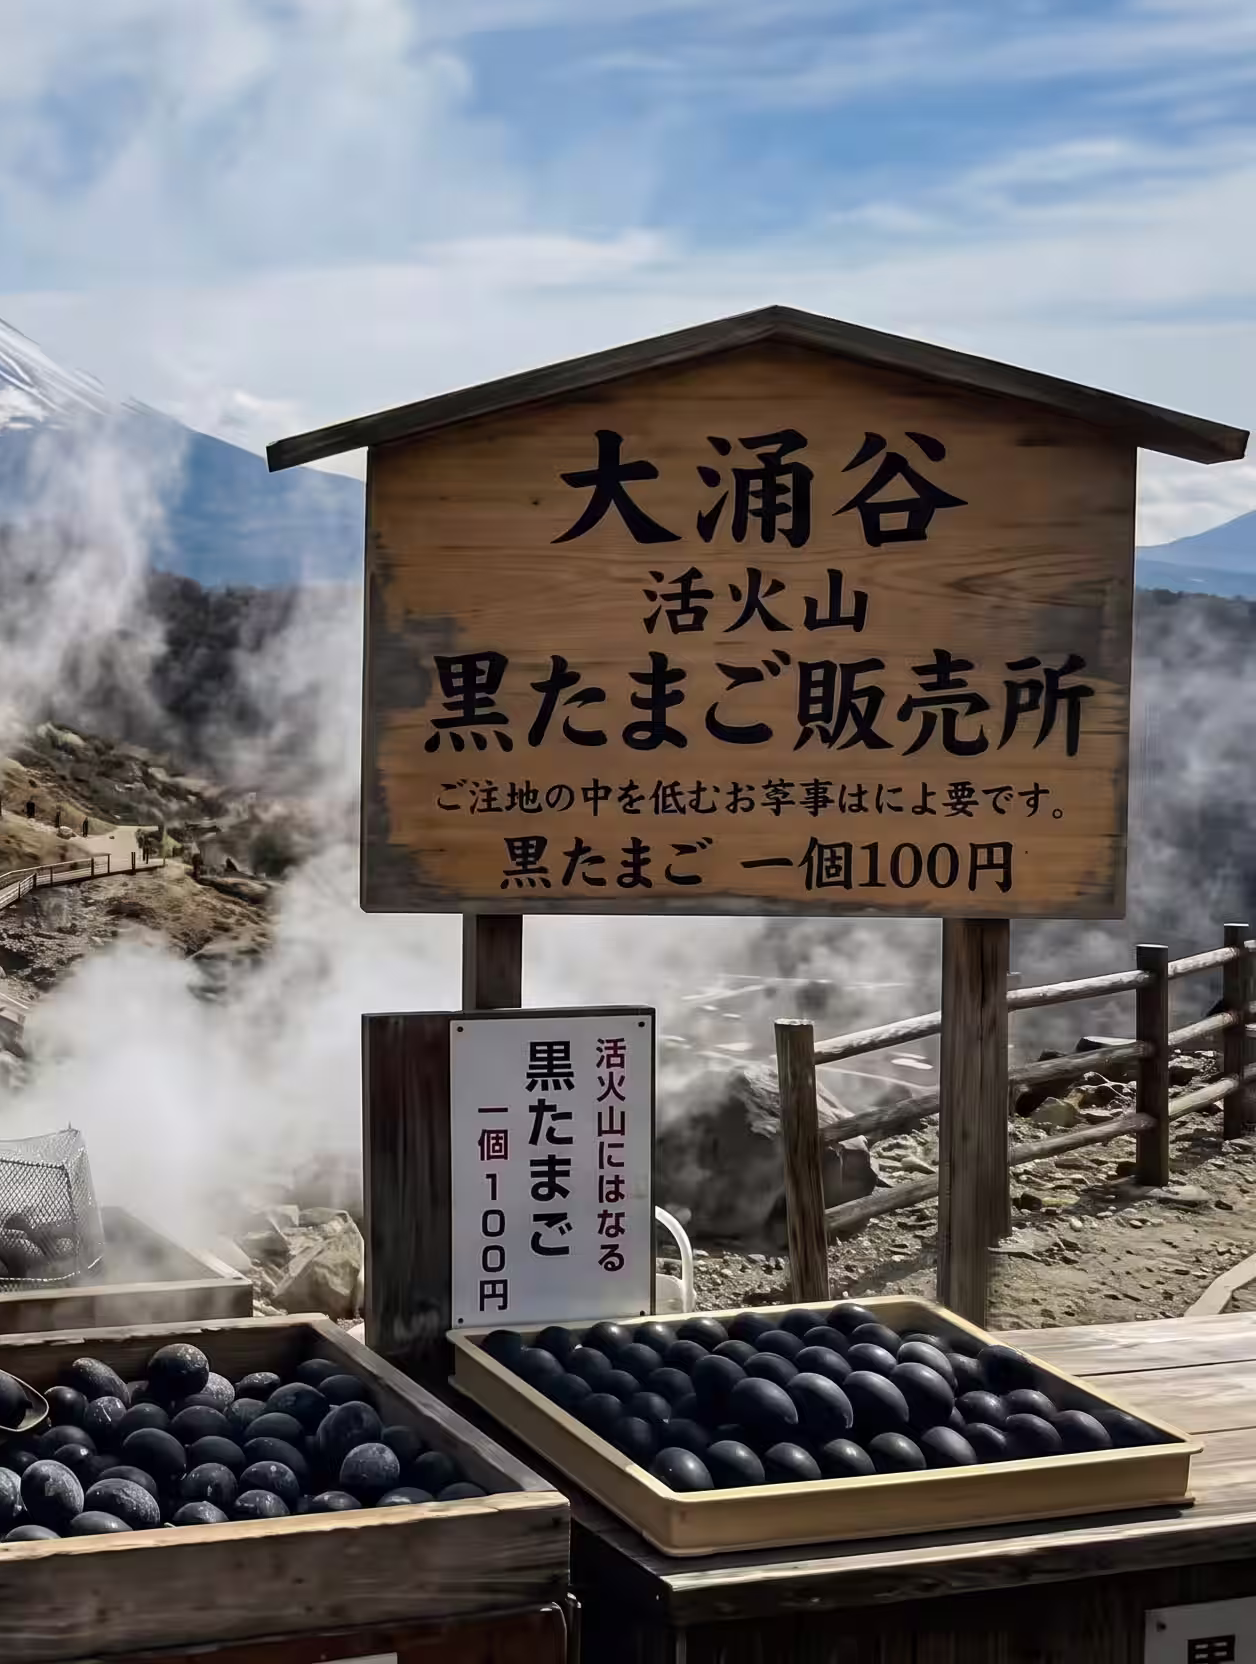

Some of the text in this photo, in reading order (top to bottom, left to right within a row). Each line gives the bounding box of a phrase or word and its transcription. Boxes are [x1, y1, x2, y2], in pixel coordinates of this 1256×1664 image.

[551, 429, 969, 548] 大涌谷
[643, 566, 869, 635] 活火山
[424, 649, 1095, 757] 黒たまご販売所
[500, 836, 1014, 894] 黒たまご 一個100円
[525, 1040, 575, 1257] 黒たまご
[596, 1037, 627, 1273] 活火山にはなる
[477, 1105, 509, 1312] 一個100円
